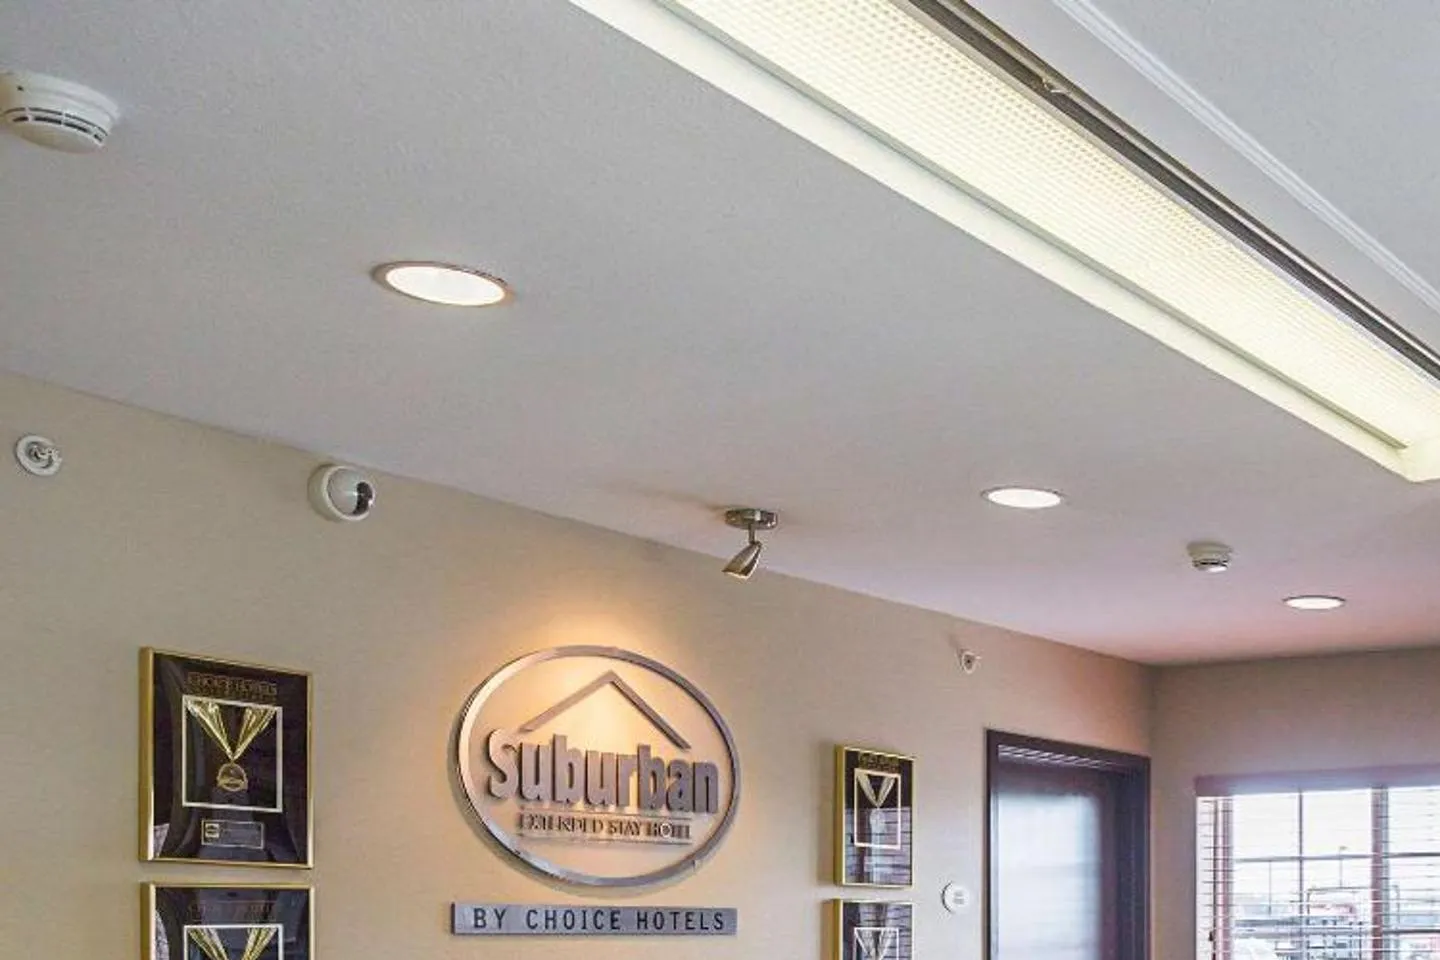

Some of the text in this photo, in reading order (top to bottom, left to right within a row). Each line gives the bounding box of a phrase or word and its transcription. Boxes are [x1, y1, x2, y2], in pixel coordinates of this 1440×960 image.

[486, 729, 718, 813] Suburban
[607, 817, 642, 836] STAY
[472, 907, 725, 932] BY CHOICE HOTELS
